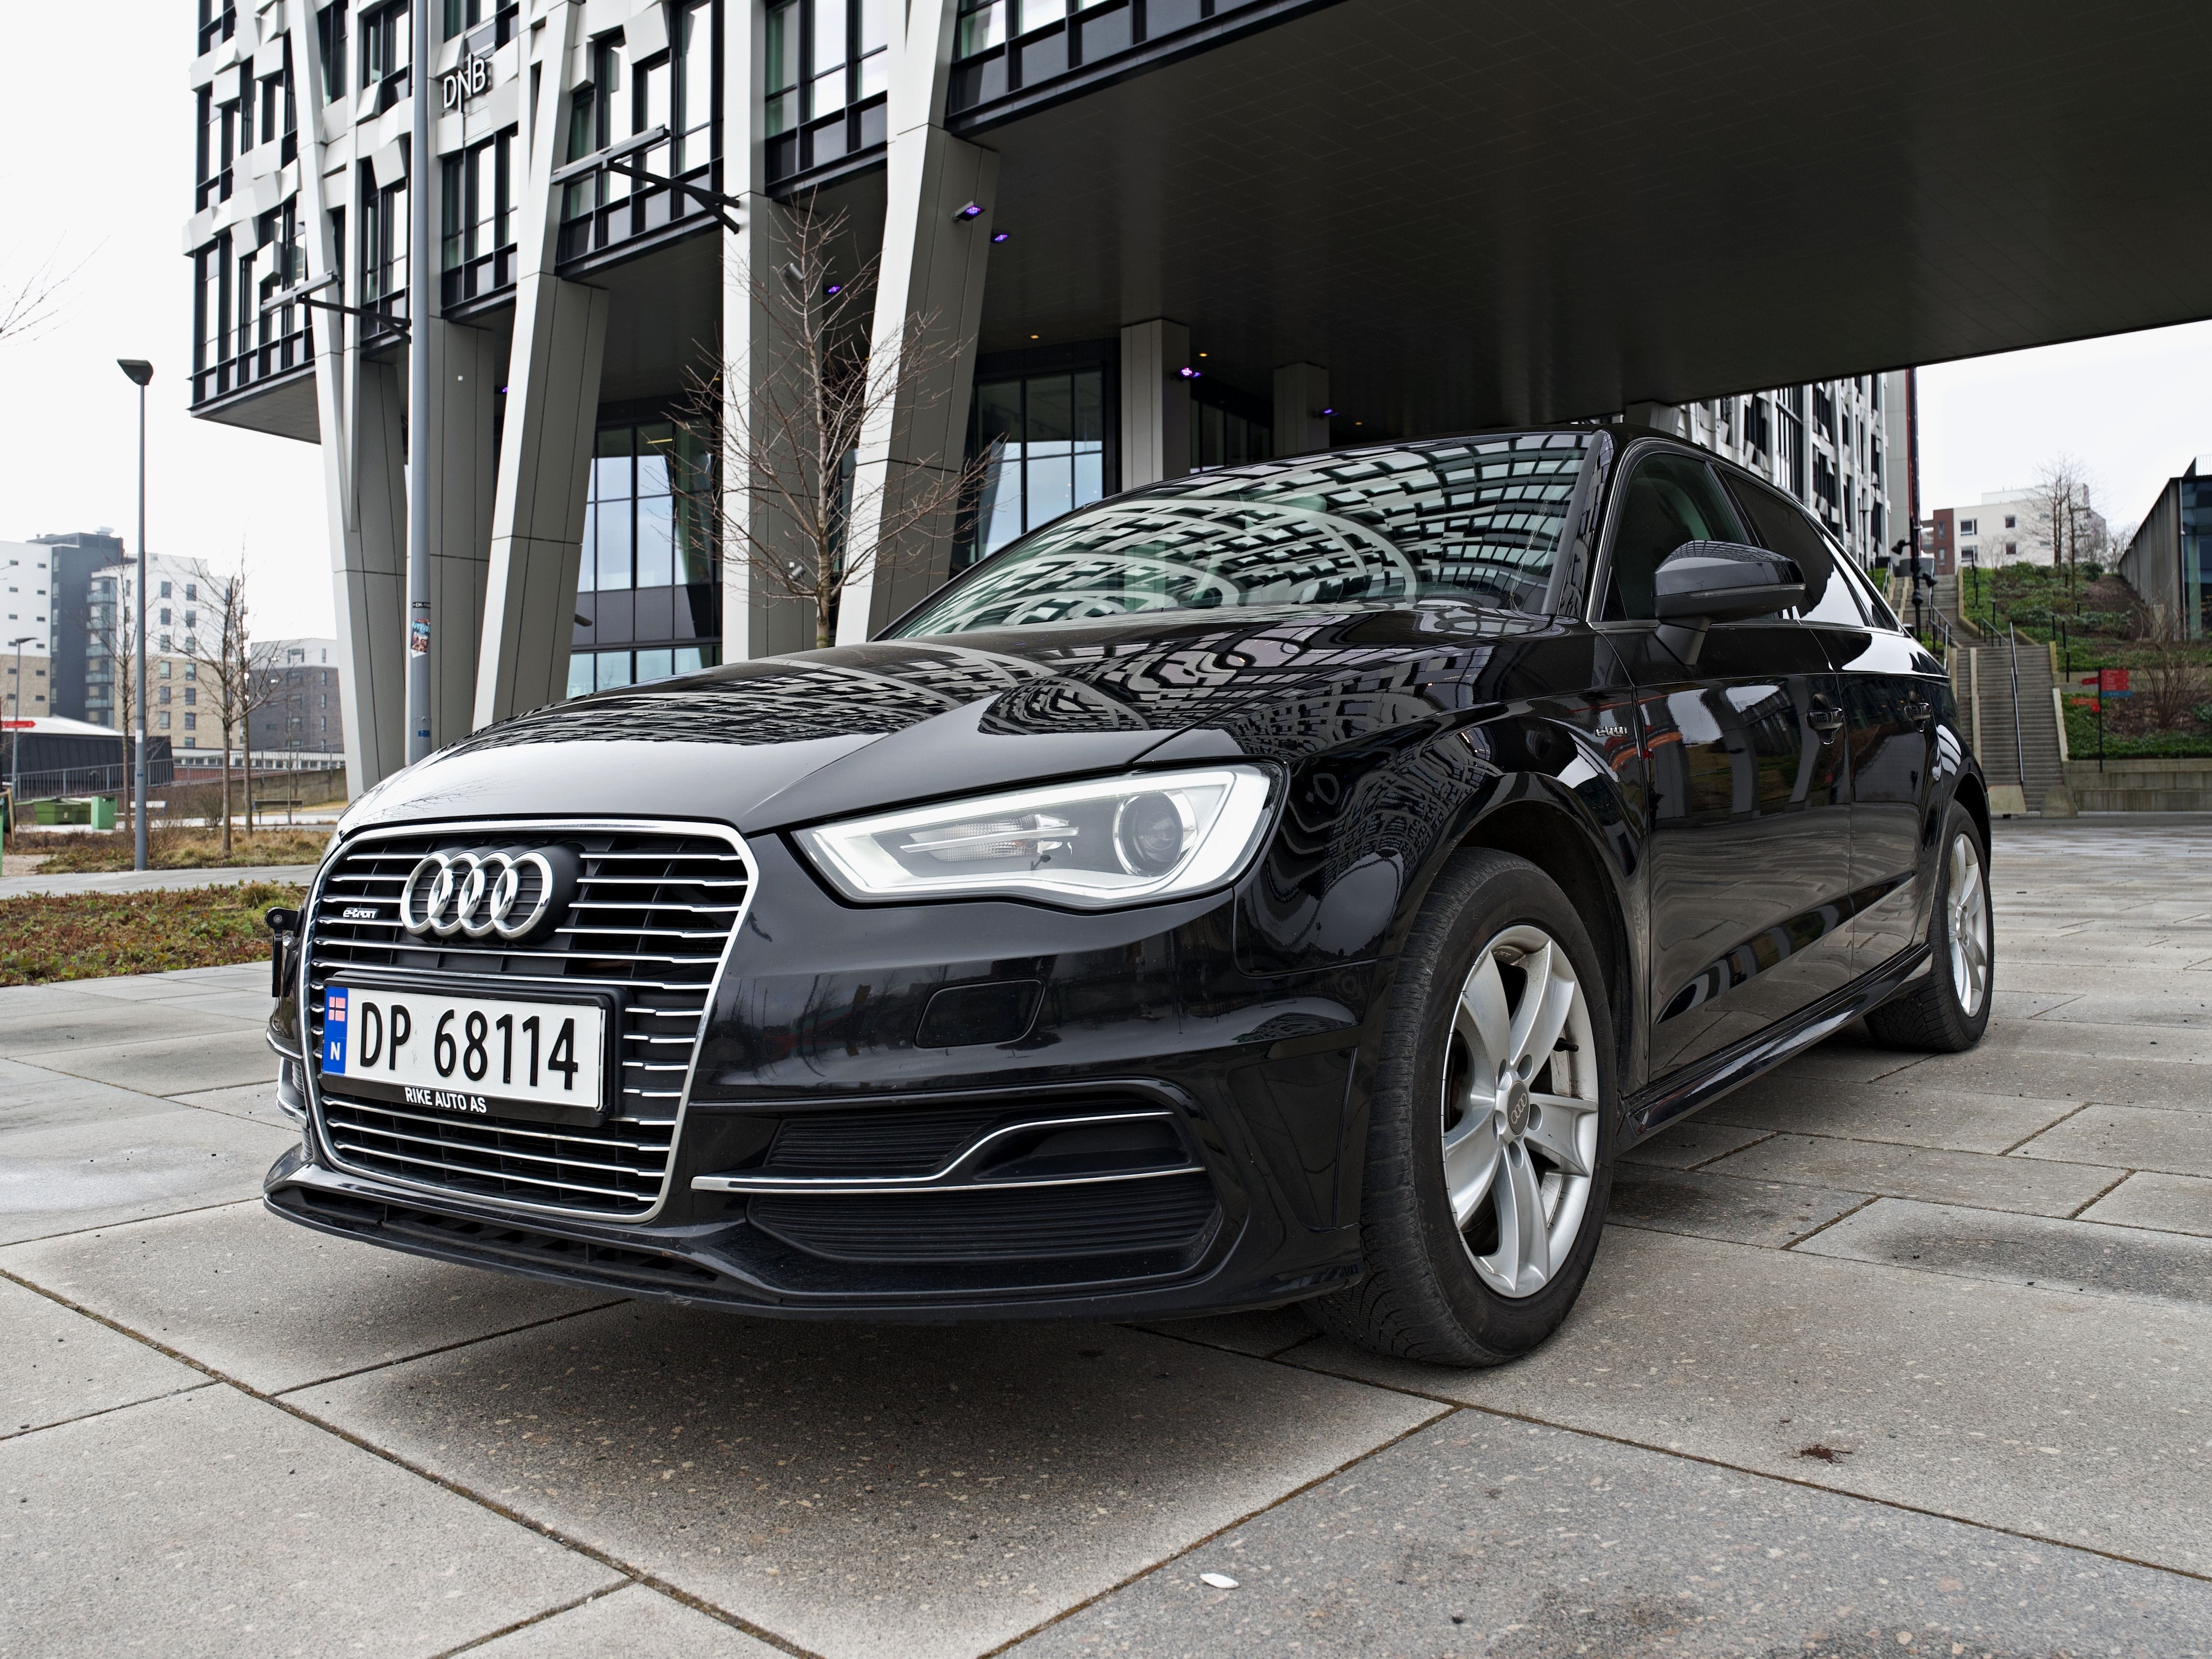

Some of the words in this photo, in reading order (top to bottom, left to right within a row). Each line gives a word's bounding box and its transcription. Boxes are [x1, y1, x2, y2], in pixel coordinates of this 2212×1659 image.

[443, 52, 486, 113] DNB
[343, 908, 376, 919] e-tron
[330, 1041, 341, 1061] N
[360, 1001, 411, 1070] DP
[434, 1009, 578, 1090] 68114
[404, 1087, 433, 1106] RIKE
[435, 1091, 467, 1110] AUTO
[470, 1096, 487, 1113] AS
